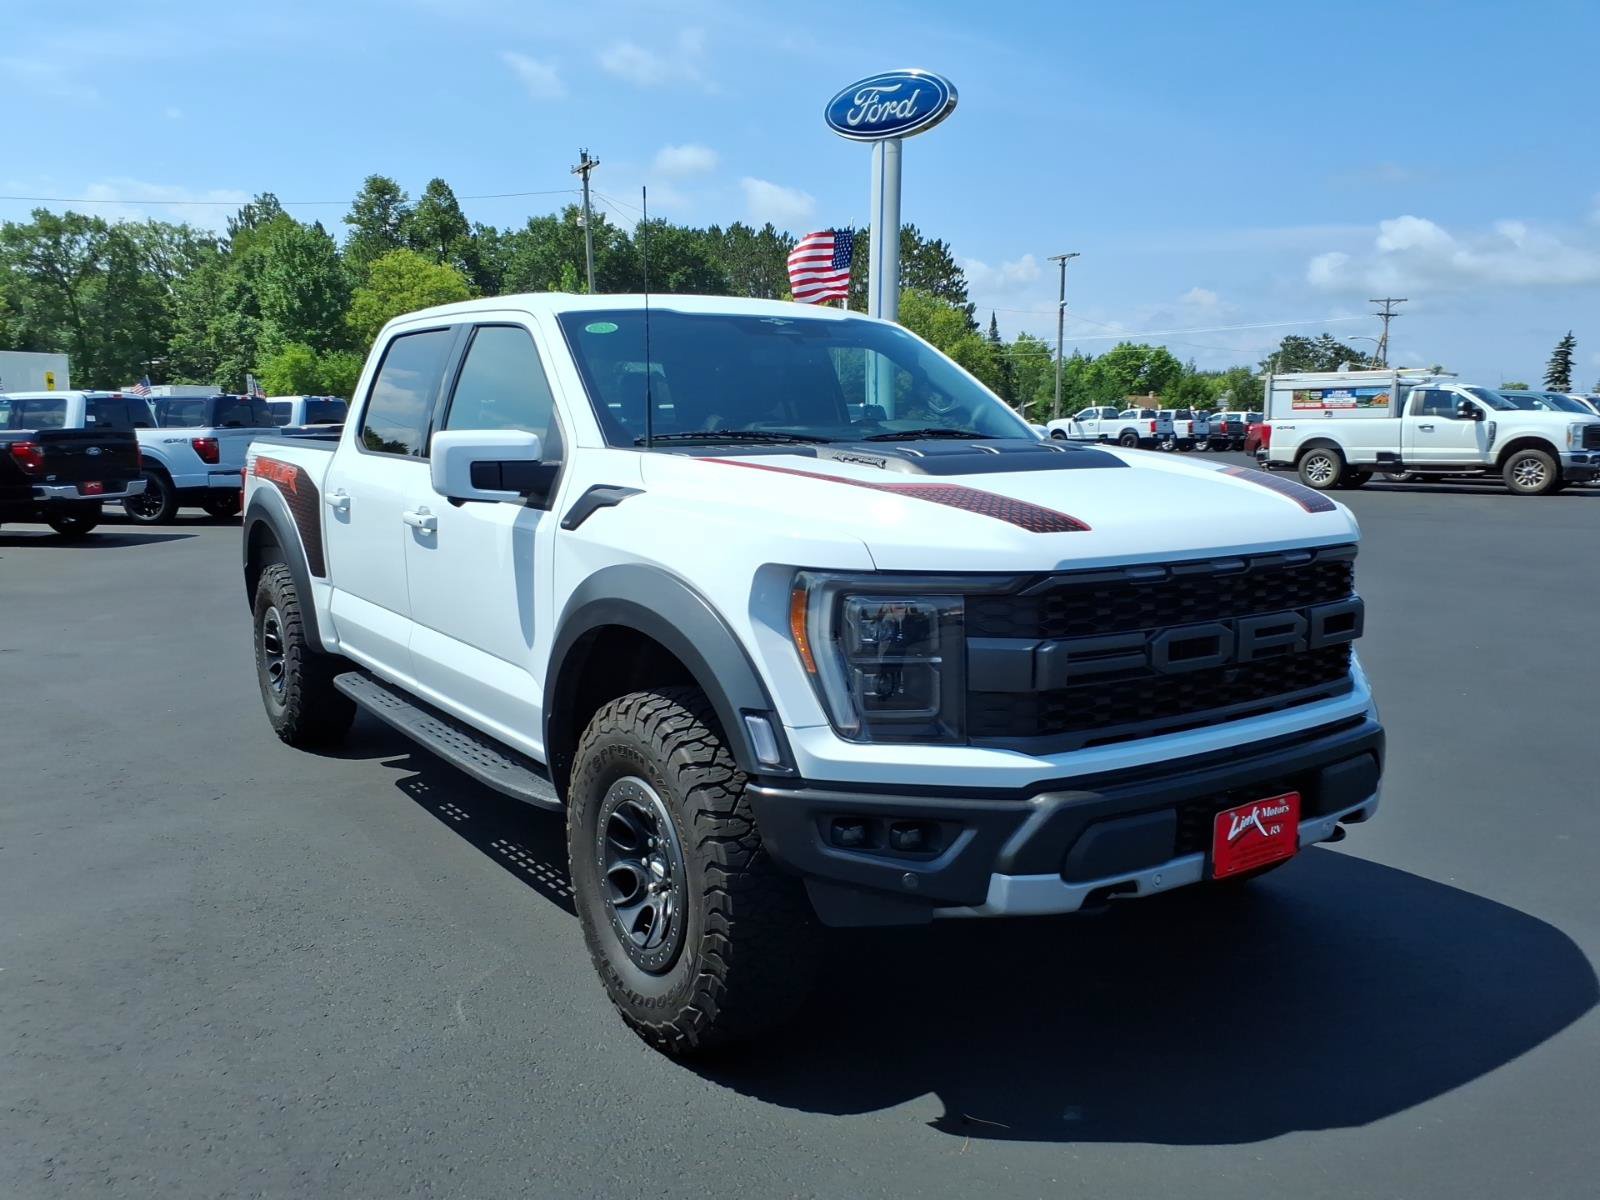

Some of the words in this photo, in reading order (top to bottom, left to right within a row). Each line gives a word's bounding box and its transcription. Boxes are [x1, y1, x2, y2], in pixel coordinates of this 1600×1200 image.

[847, 83, 920, 126] Ford
[1036, 597, 1364, 690] FORD
[1262, 804, 1289, 817] Motors
